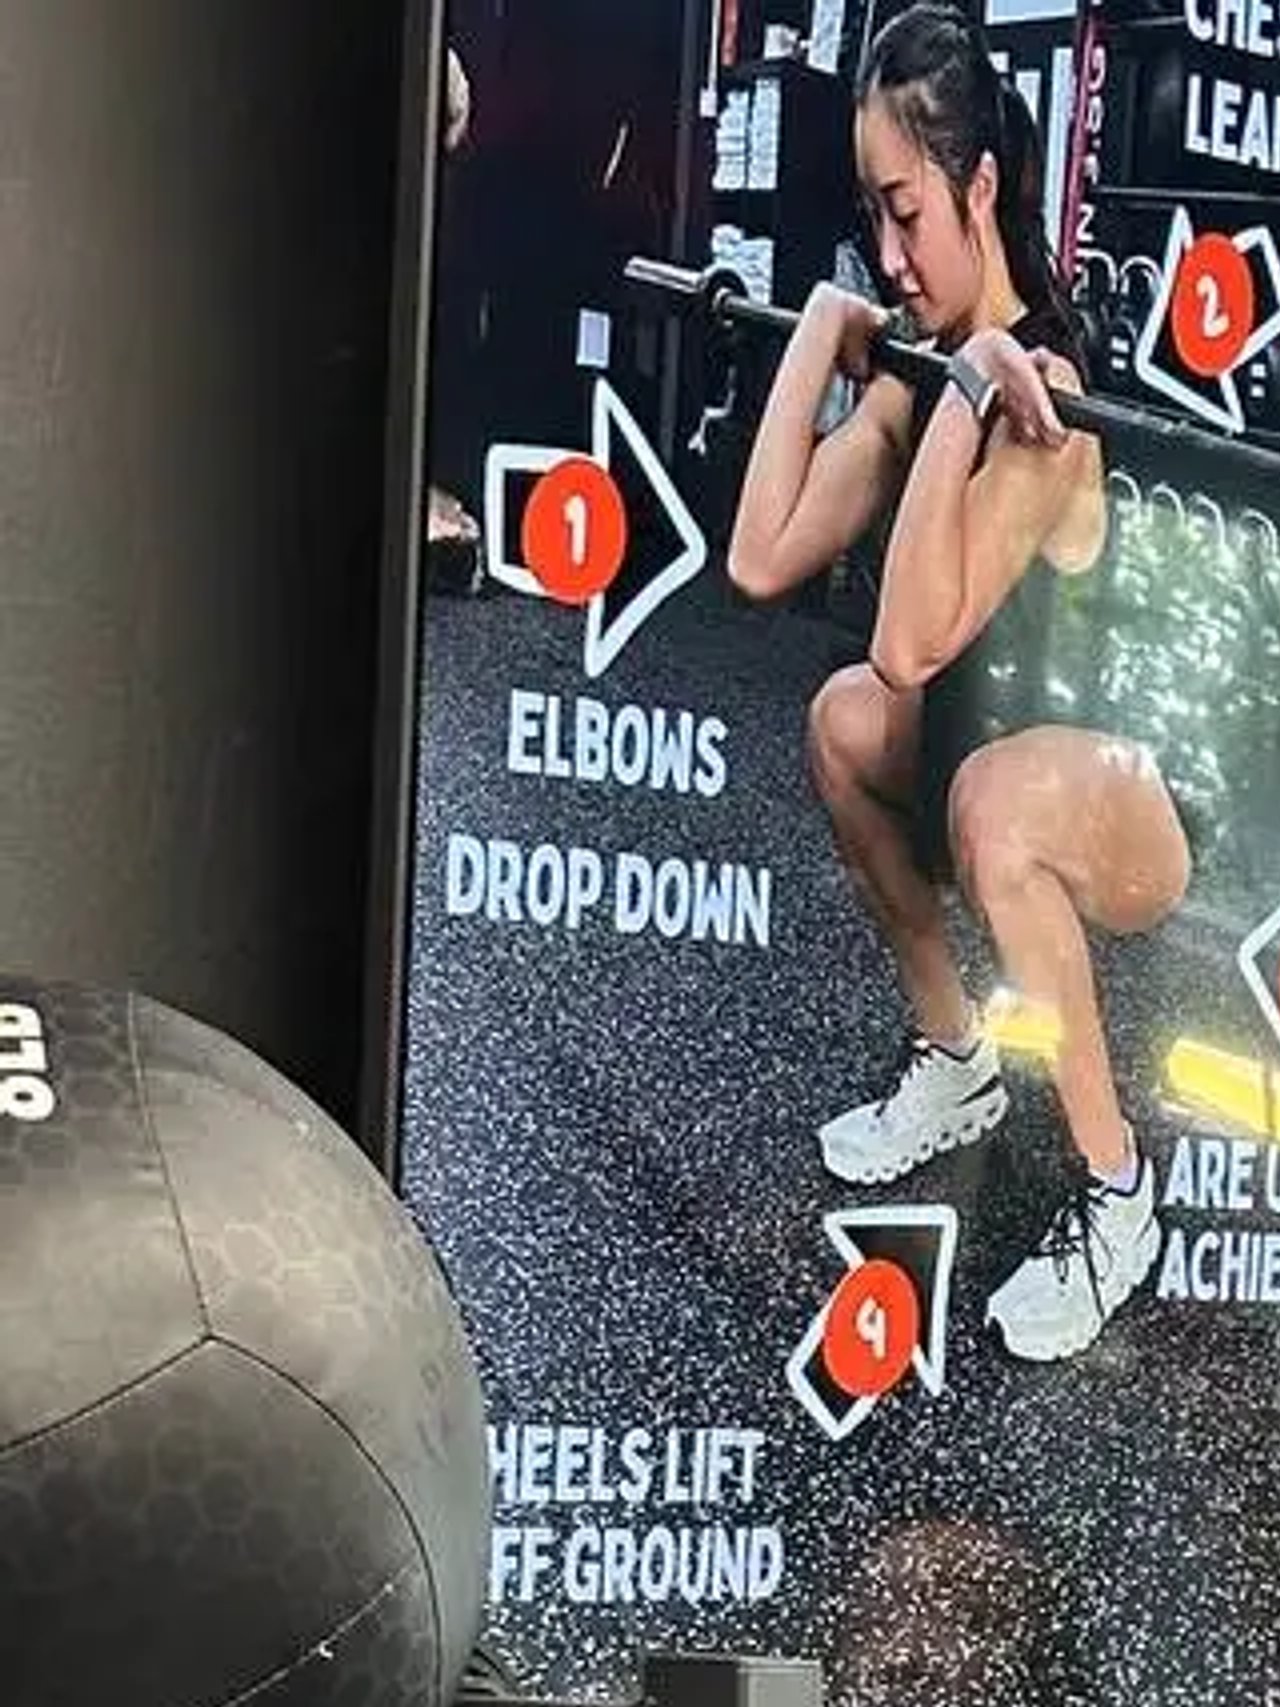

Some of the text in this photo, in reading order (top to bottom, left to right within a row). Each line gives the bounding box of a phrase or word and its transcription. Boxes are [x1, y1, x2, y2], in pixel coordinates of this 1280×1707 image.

[1197, 276, 1229, 338] 2
[563, 494, 587, 565] 1
[507, 689, 727, 796] ELBOWS
[447, 834, 772, 947] DROP DOWN
[1164, 1136, 1254, 1210] ARE
[855, 1300, 887, 1359] 4
[487, 1424, 765, 1503] HEELS LIFT
[489, 1525, 785, 1604] FF GROUND
